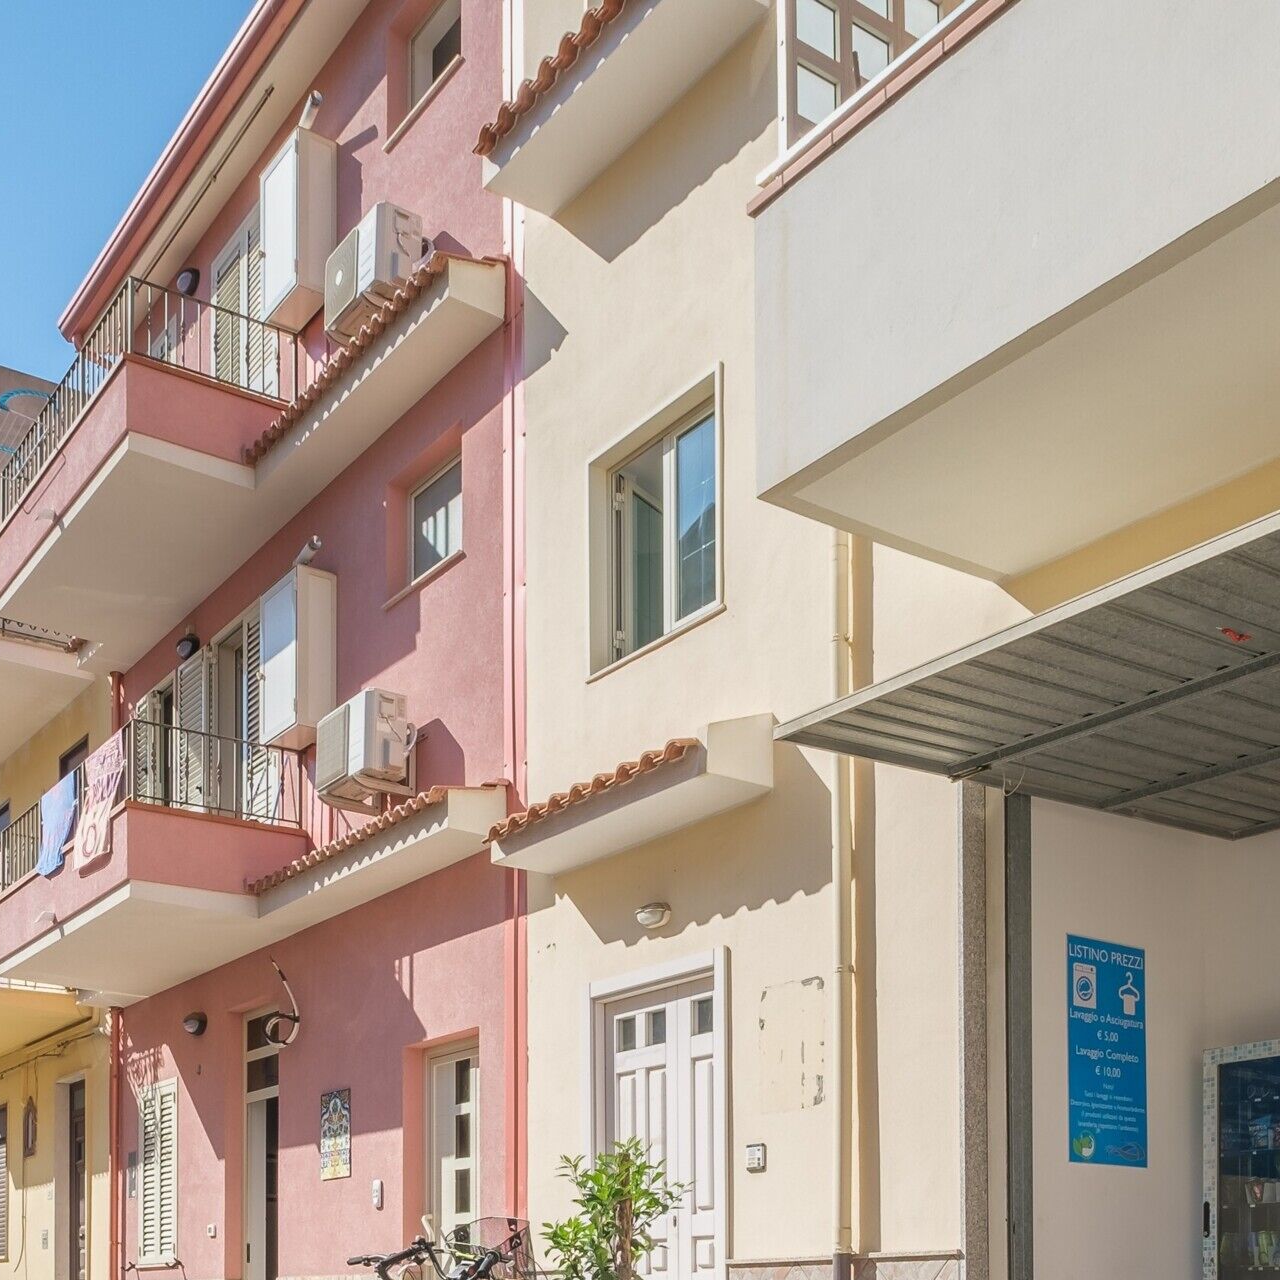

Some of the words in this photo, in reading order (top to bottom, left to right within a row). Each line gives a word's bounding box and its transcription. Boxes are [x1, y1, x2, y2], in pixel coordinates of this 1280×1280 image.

[1068, 943, 1108, 962] LISTINO
[1110, 951, 1143, 970] PREZZI
[1069, 1007, 1098, 1023] Lavaggio
[1100, 1015, 1105, 1023] o
[1105, 1013, 1143, 1029] Asciugatura
[1096, 1030, 1102, 1040] €
[1075, 1044, 1104, 1060] Lavaggio
[1106, 1049, 1139, 1063] Completo
[1095, 1065, 1101, 1075] €
